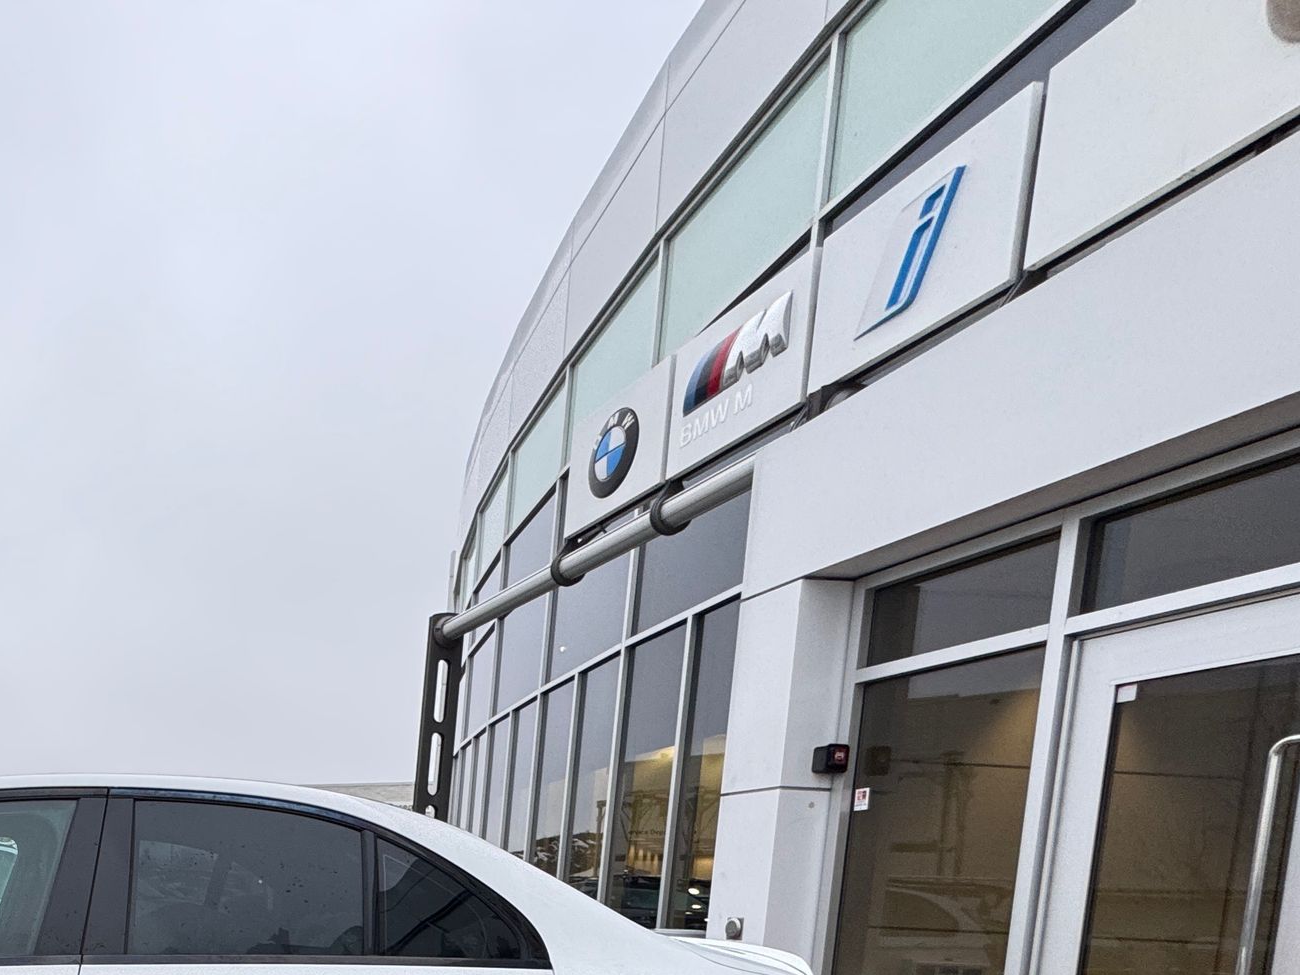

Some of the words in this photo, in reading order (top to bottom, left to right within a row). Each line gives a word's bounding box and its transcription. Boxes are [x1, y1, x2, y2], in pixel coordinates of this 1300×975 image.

[593, 411, 635, 450] BMW
[679, 398, 729, 448] BMW
[733, 383, 753, 415] M
